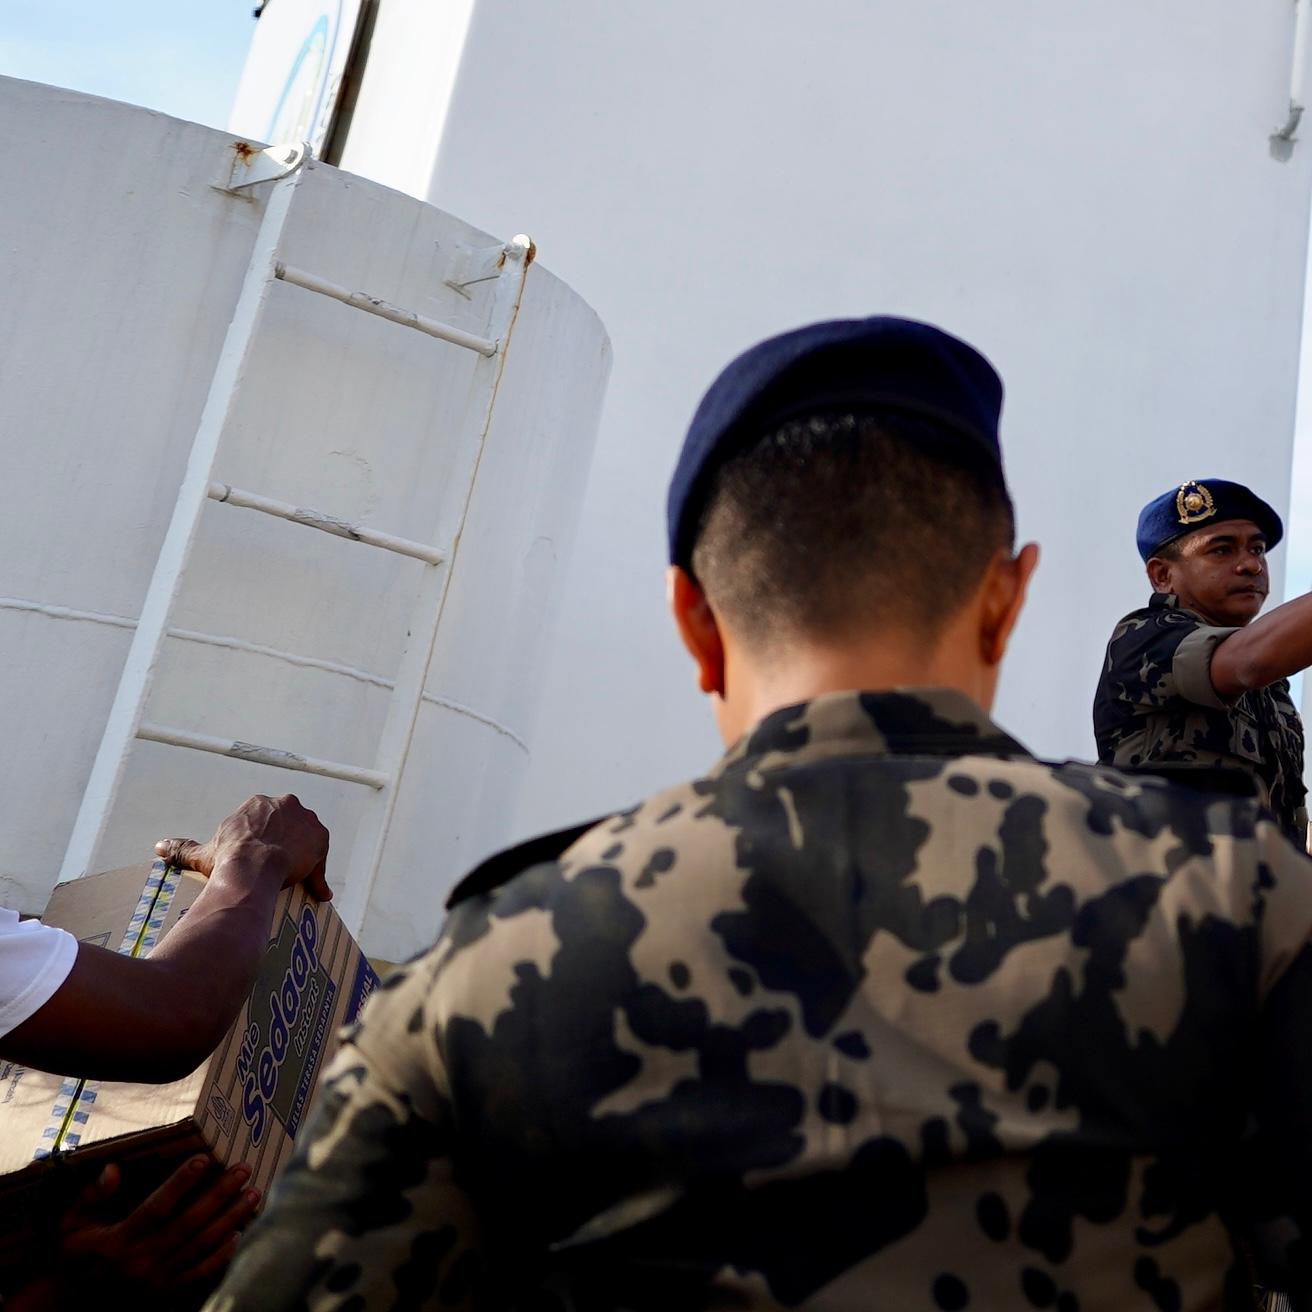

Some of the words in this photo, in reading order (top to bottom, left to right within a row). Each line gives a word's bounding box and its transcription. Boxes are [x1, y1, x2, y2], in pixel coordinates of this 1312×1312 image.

[236, 1023, 260, 1085] Mie
[242, 902, 319, 1149] Sedaap
[290, 1095, 305, 1131] JELAS
[301, 1051, 318, 1091] TERASA
[315, 989, 335, 1046] SEDAPNYA
[293, 976, 320, 1057] Instant
